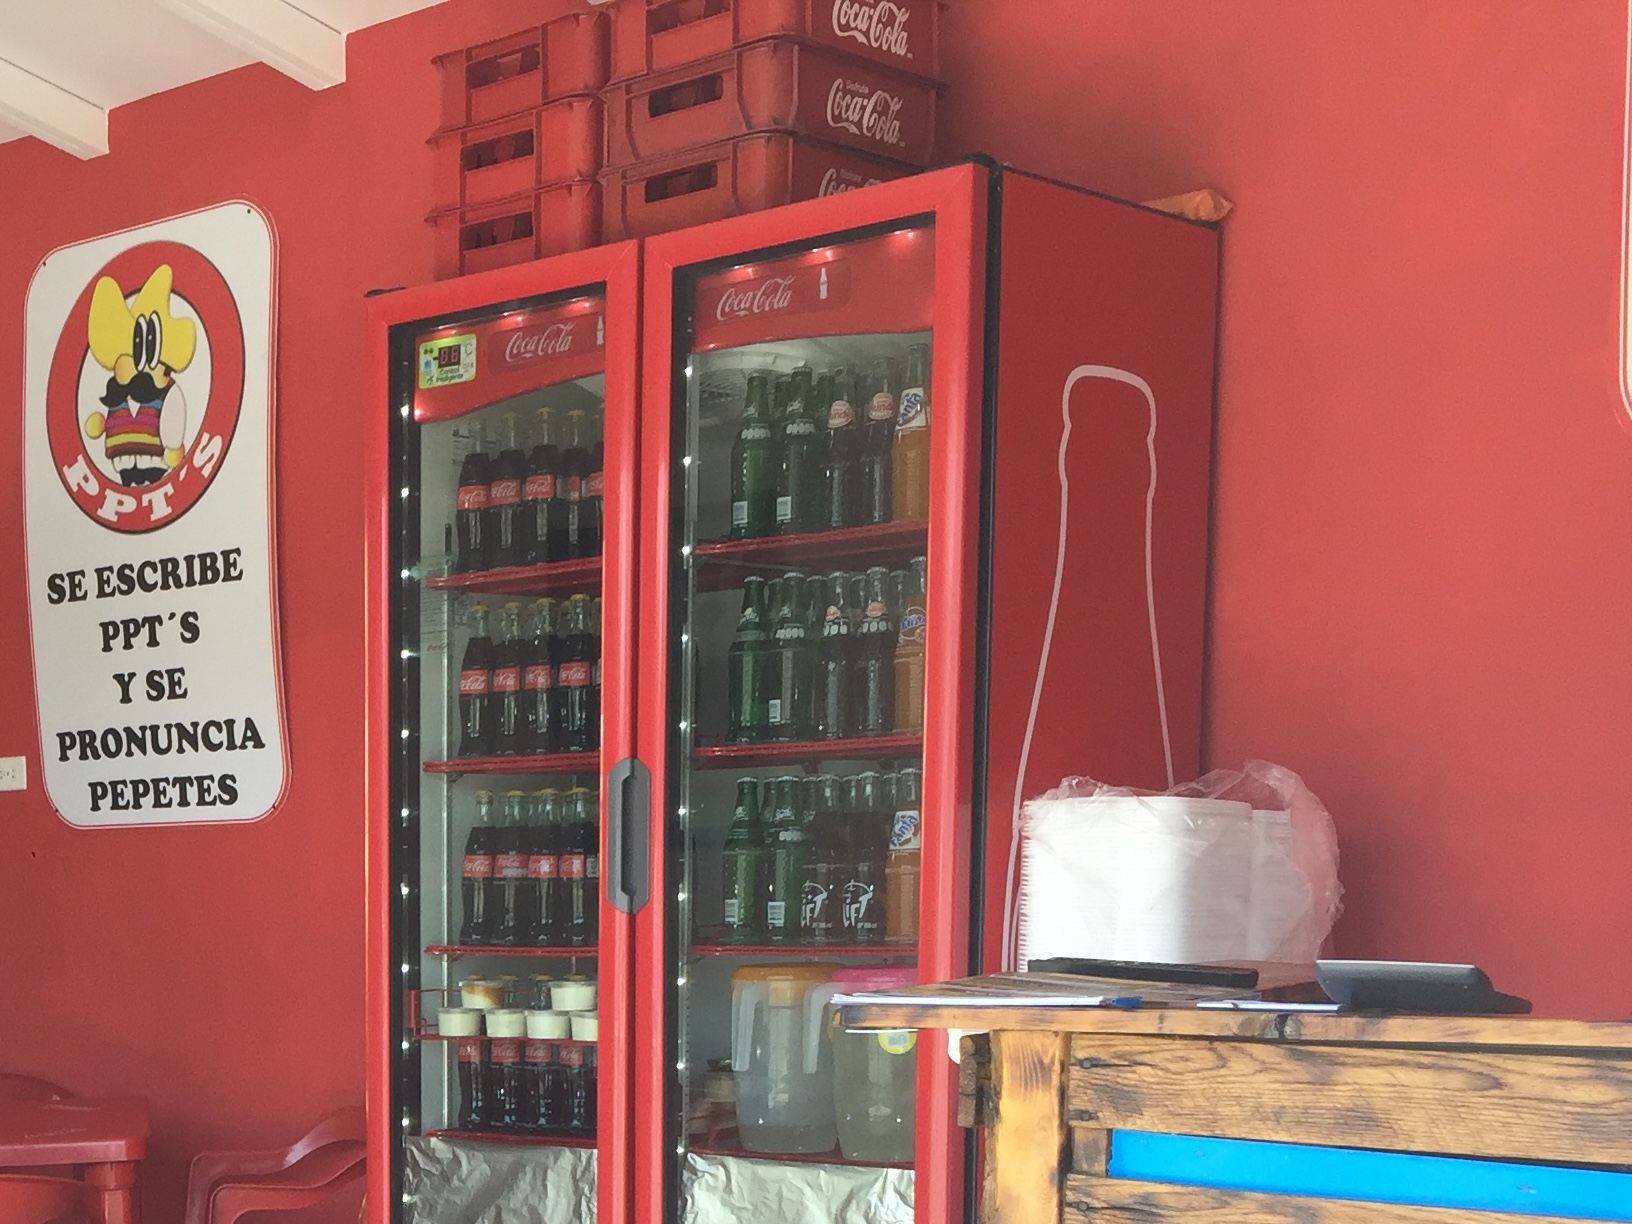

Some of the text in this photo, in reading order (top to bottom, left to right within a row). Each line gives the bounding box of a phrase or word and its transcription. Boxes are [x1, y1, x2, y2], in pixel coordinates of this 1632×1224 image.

[832, 0, 910, 57] Coca-Cola
[827, 78, 903, 144] Coca-Cola
[716, 275, 796, 321] Coca-Cola
[505, 321, 576, 363] Coca-Cola
[46, 547, 244, 605] SE ESCRIBE
[113, 667, 188, 704] Y SE
[56, 717, 266, 762] PRONUNCIA
[88, 774, 239, 812] PEPETES
